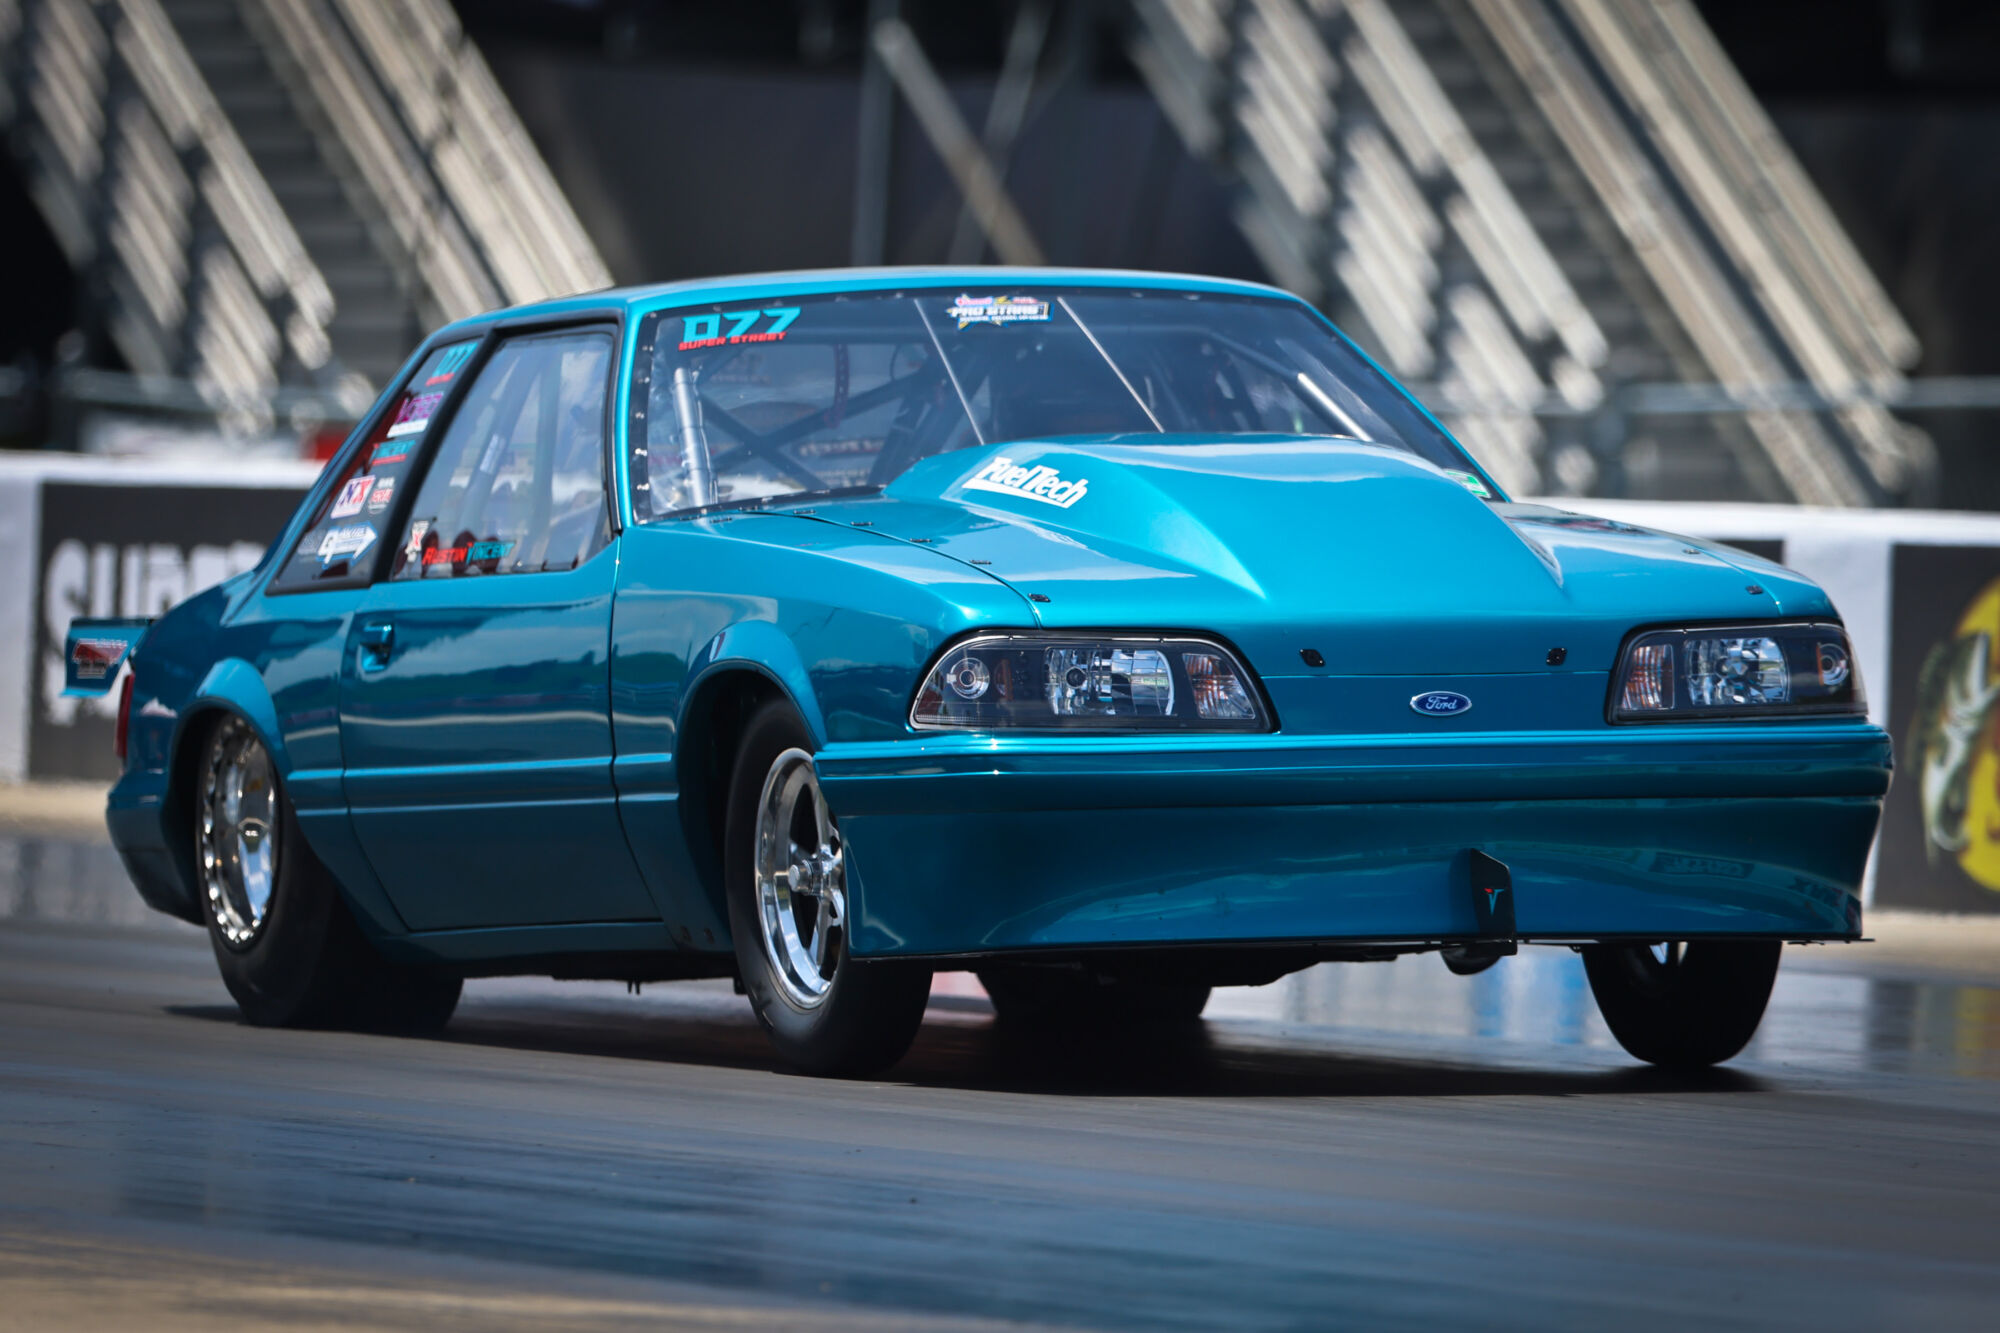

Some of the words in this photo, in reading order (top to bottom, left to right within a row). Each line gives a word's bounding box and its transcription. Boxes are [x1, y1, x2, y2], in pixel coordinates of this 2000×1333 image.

[681, 306, 801, 343] 077
[678, 336, 727, 351] SUPER
[729, 331, 787, 345] STREET
[966, 456, 1089, 508] FuelTech
[1425, 695, 1458, 710] Ford
